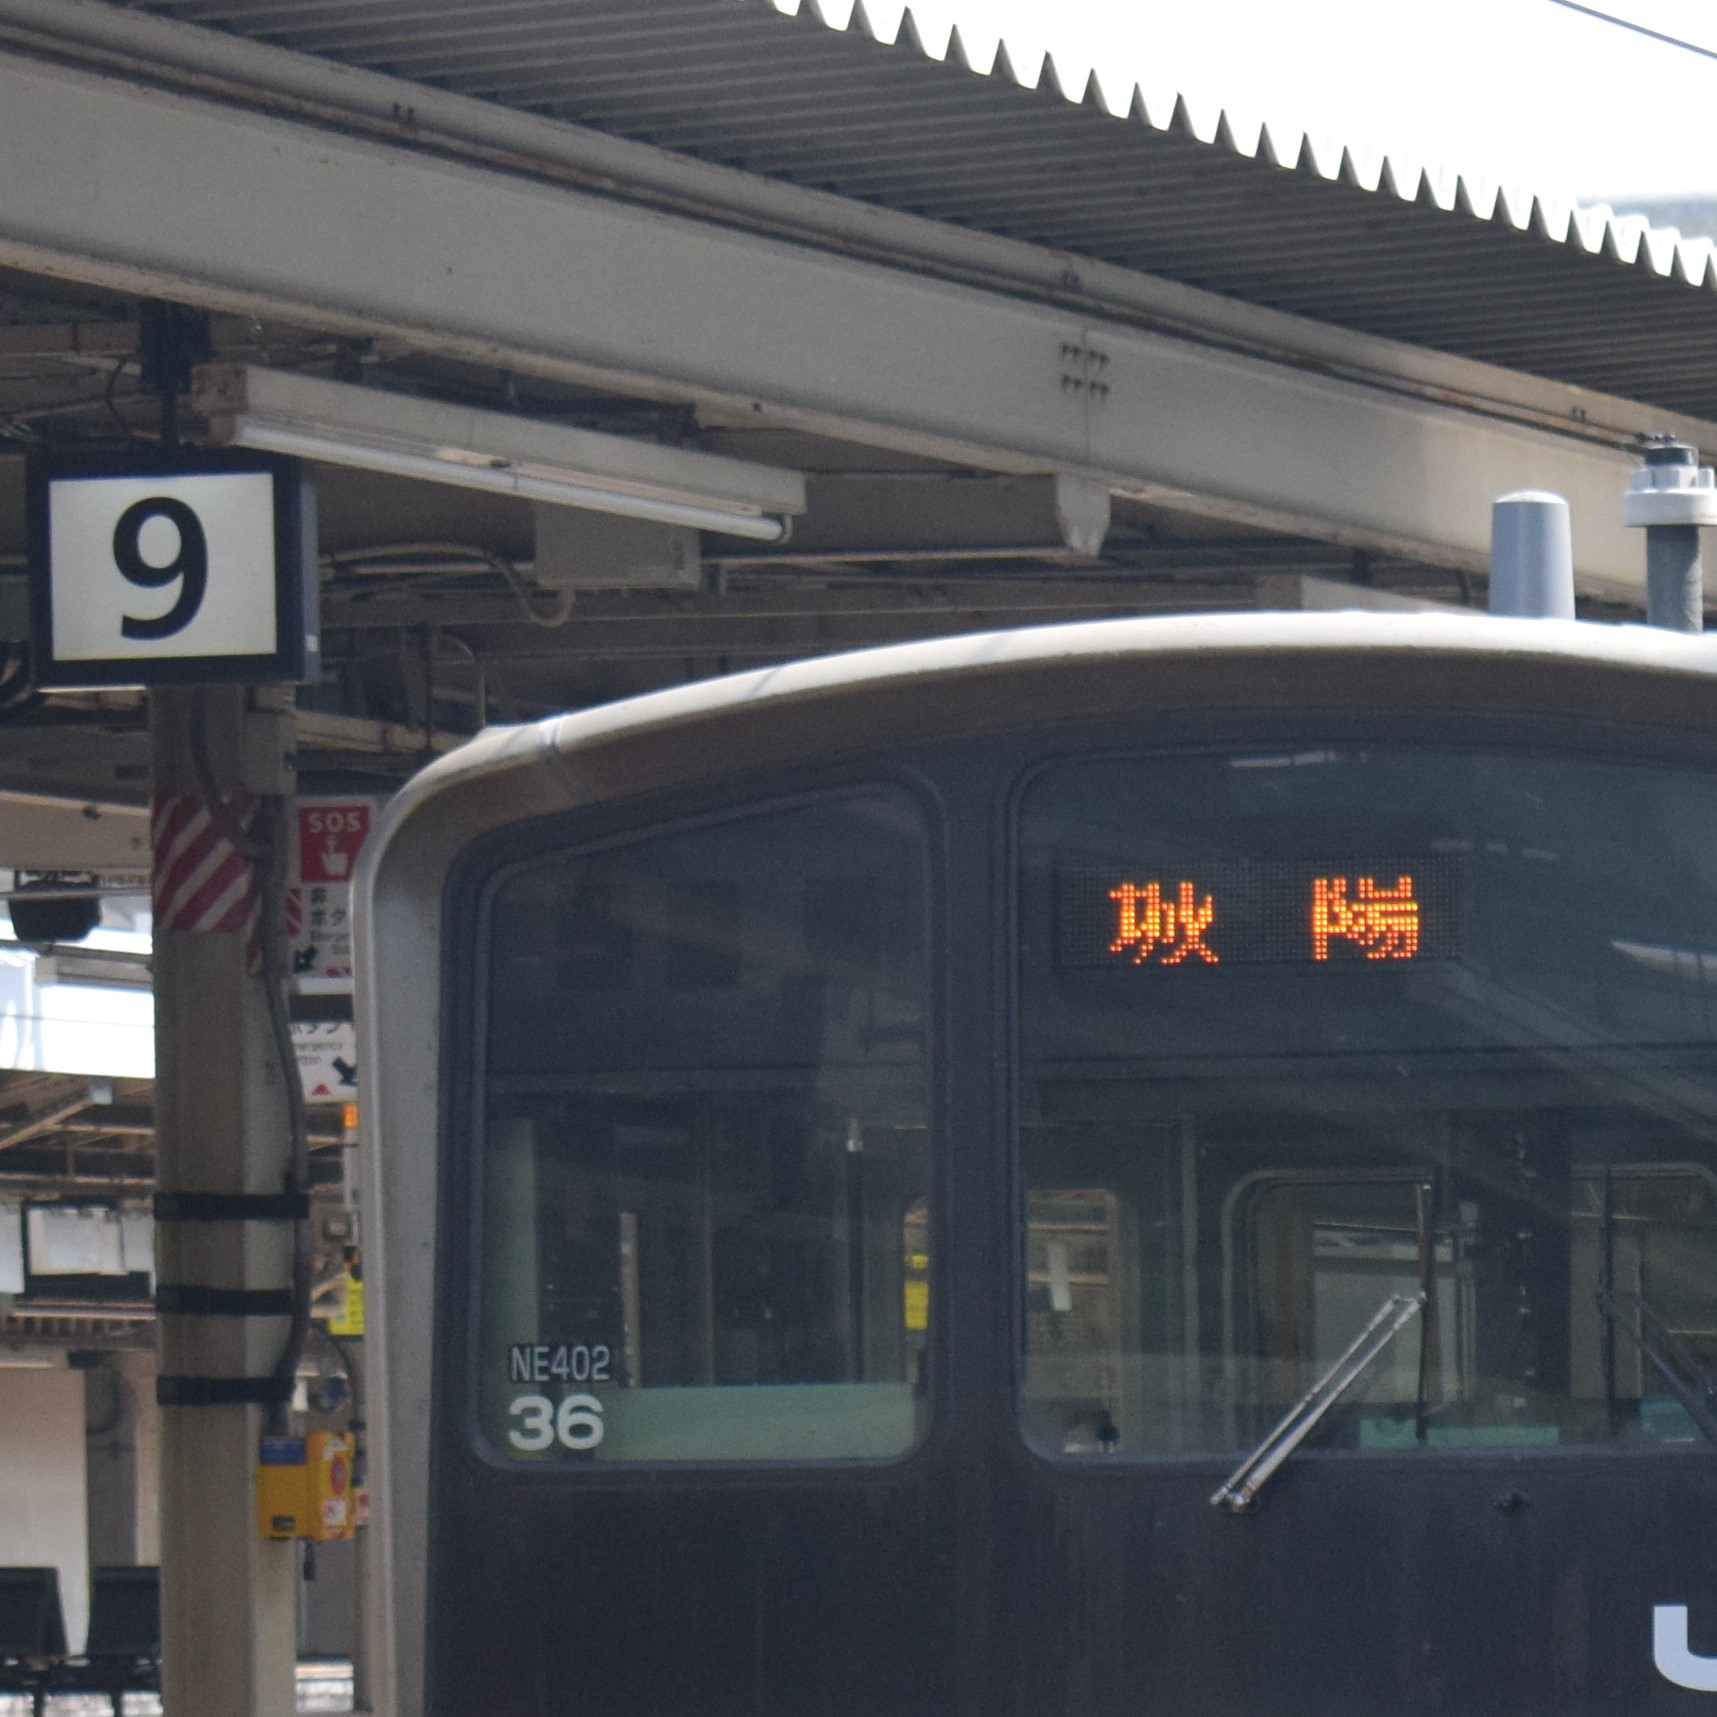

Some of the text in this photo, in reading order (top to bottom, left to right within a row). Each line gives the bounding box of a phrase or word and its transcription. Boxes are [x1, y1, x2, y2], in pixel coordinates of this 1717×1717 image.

[113, 497, 209, 640] 9
[308, 811, 361, 833] SOS
[511, 1345, 610, 1382] NE402
[508, 1394, 604, 1451] 36
